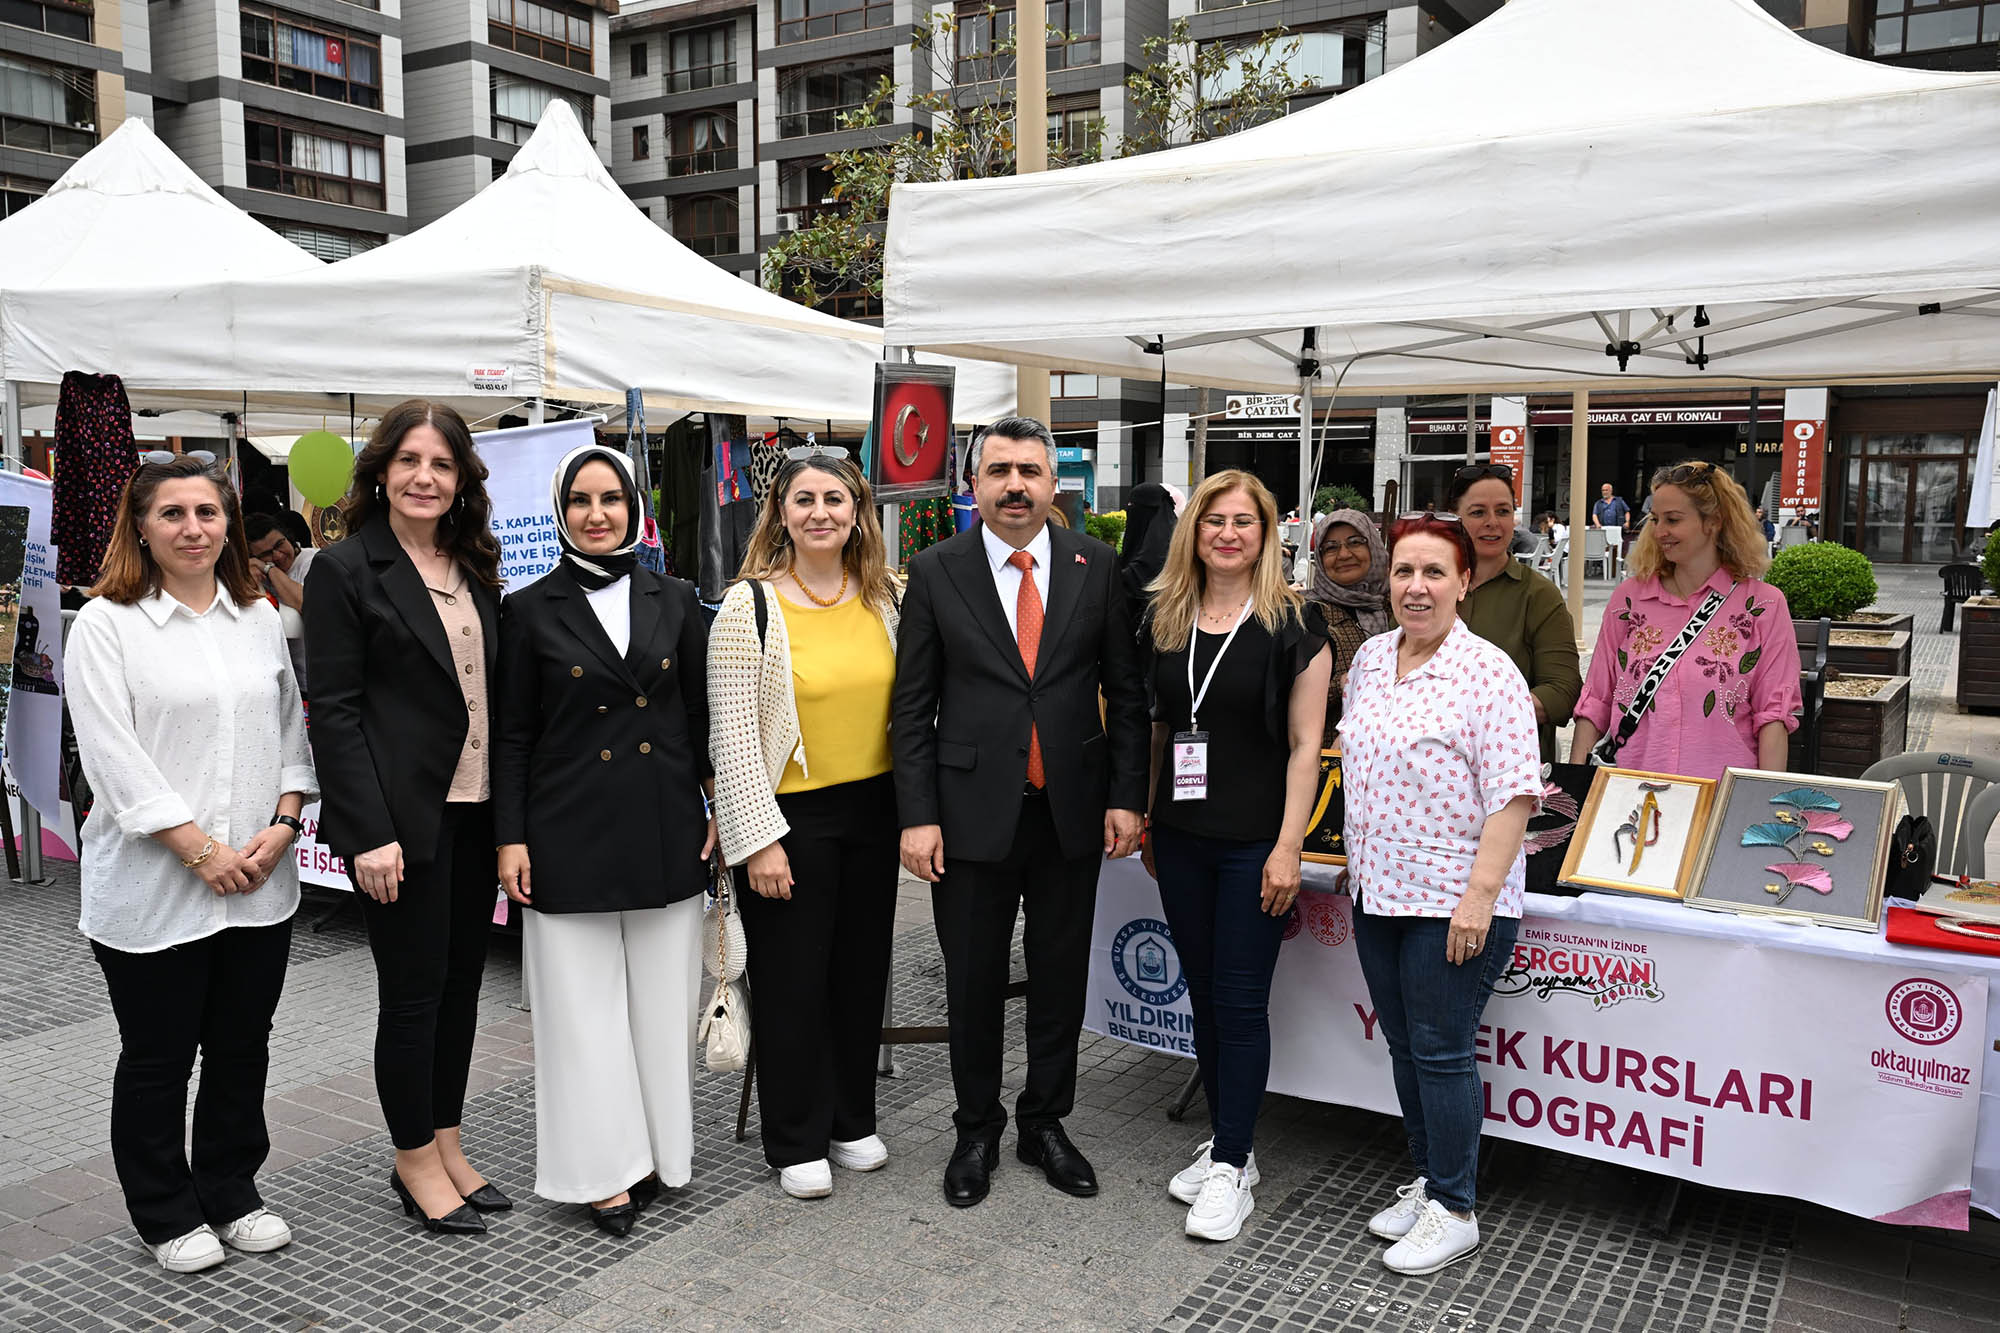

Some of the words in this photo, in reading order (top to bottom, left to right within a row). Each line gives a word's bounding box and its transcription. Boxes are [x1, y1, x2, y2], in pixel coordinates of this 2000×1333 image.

[1245, 406, 1266, 418] ÇAY
[1586, 413, 1627, 423] BUHARA
[1631, 413, 1651, 423] ÇAY
[1677, 411, 1722, 422] KONYALI
[1429, 423, 1457, 433] BUHARA
[1740, 442, 1784, 453] BHARA
[1782, 497, 1800, 506] ÇAY
[1802, 496, 1818, 505] EVİ
[506, 514, 555, 529] KAPLIK
[527, 527, 557, 543] GİRİ
[520, 548, 538, 559] VE
[1641, 617, 1707, 697] MARC
[1177, 776, 1204, 785] GÖREVLİ
[301, 817, 319, 837] KA
[314, 846, 347, 874] İŞLE
[1525, 929, 1551, 941] EMİR
[1553, 932, 1608, 949] SULTAN'IN
[1611, 938, 1648, 954] İZİNDE
[1514, 945, 1651, 985] ERGUVAN
[1543, 1035, 1812, 1121] KURSLARI
[1905, 1078, 1933, 1091] Belediye
[1934, 1085, 1963, 1097] Başkanı
